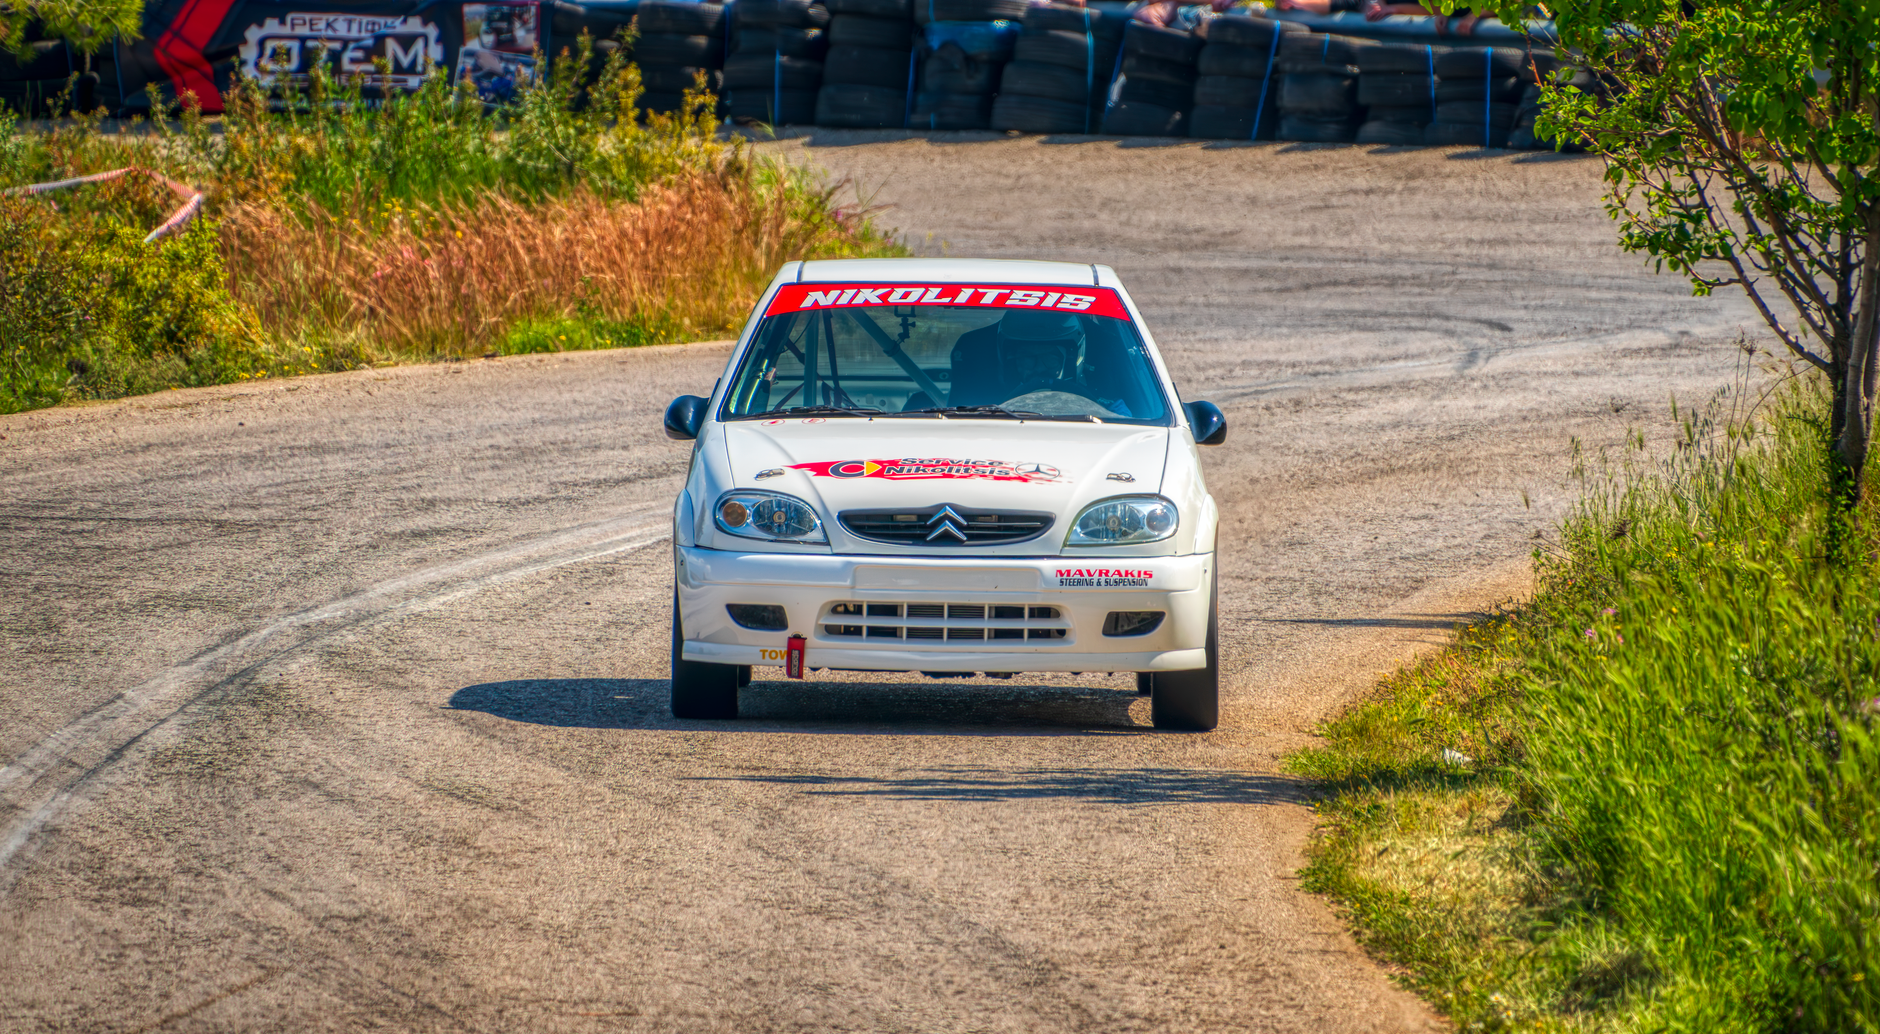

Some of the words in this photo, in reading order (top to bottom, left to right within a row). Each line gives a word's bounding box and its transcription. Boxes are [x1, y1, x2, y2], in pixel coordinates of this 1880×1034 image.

[800, 287, 1097, 311] NIKOLITSIS
[900, 457, 1004, 466] Service
[884, 465, 1010, 476] Nikolitsis
[1055, 569, 1153, 579] MAVRAKIS
[1059, 578, 1095, 586] STEERING
[1096, 578, 1102, 586] &
[1104, 578, 1148, 586] SUSPENSION
